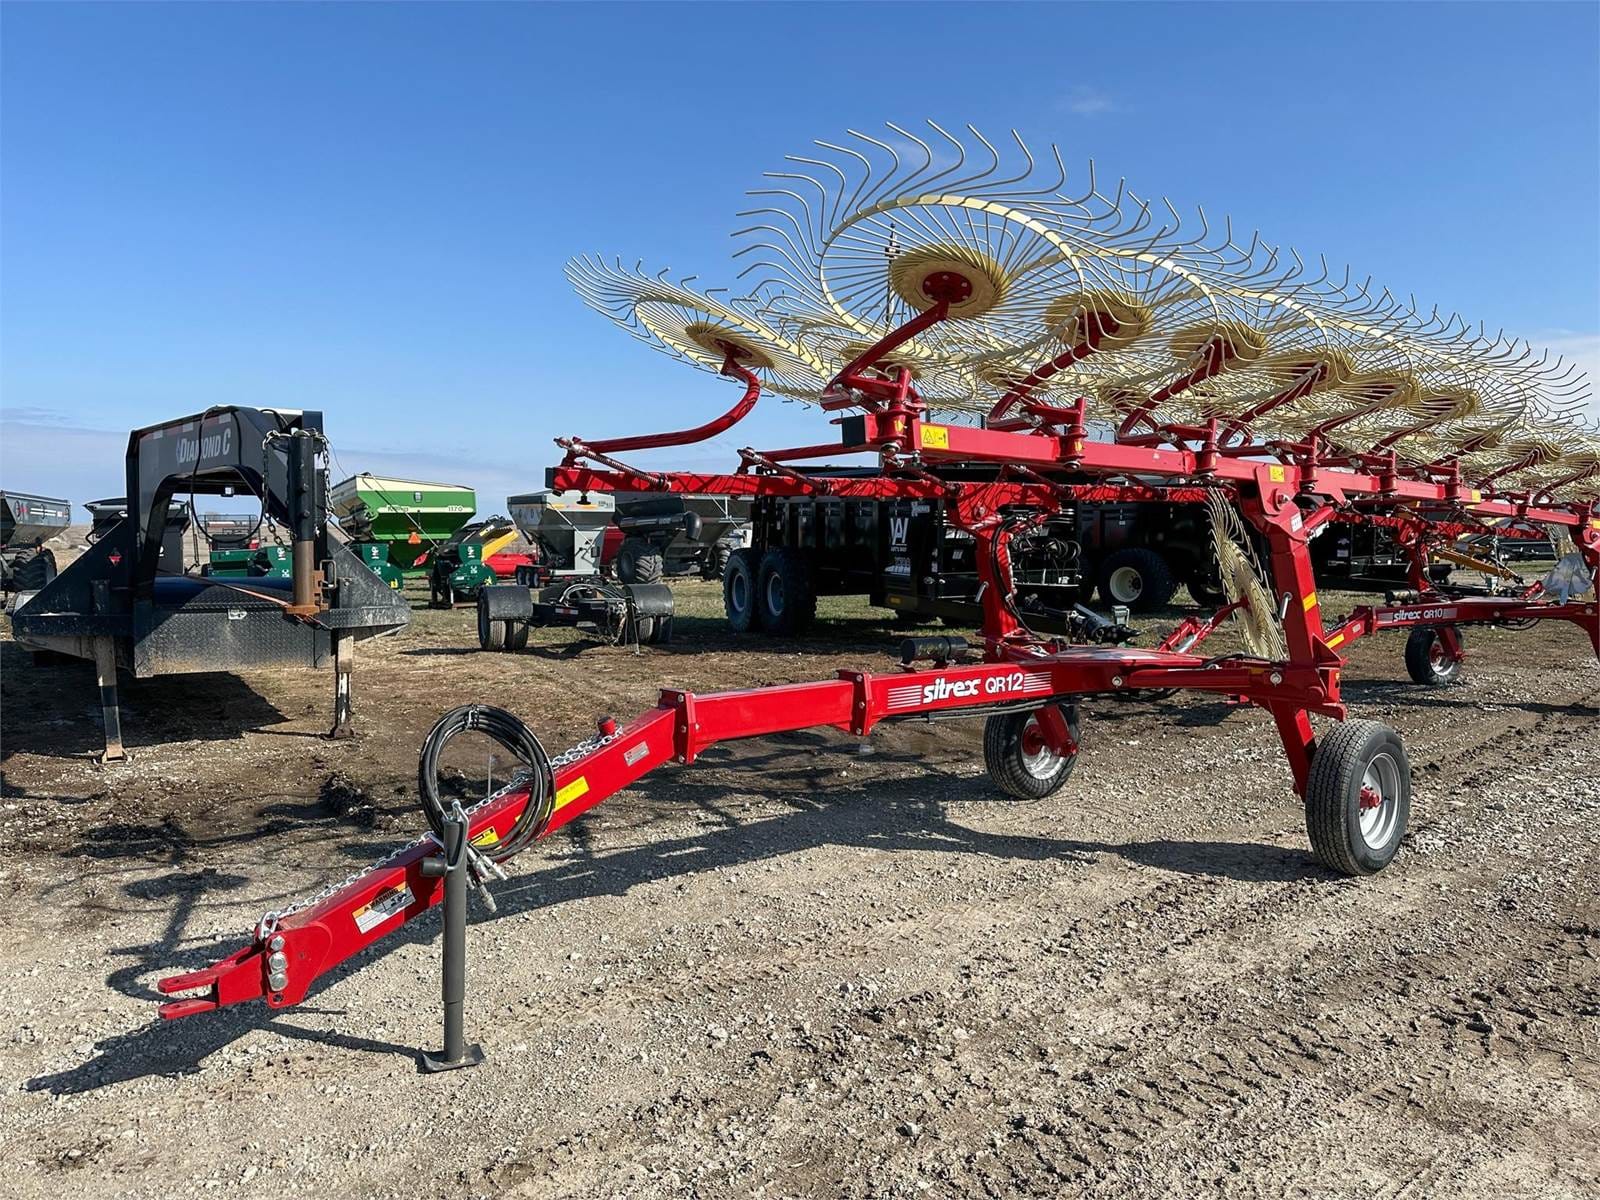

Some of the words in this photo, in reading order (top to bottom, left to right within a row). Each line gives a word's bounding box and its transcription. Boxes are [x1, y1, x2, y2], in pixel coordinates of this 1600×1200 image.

[222, 427, 231, 455] C
[1393, 609, 1422, 623] sitrex
[1423, 608, 1443, 619] QR10
[922, 677, 981, 704] sitrex
[985, 672, 1023, 693] QR12
[369, 887, 399, 909] WARNING
